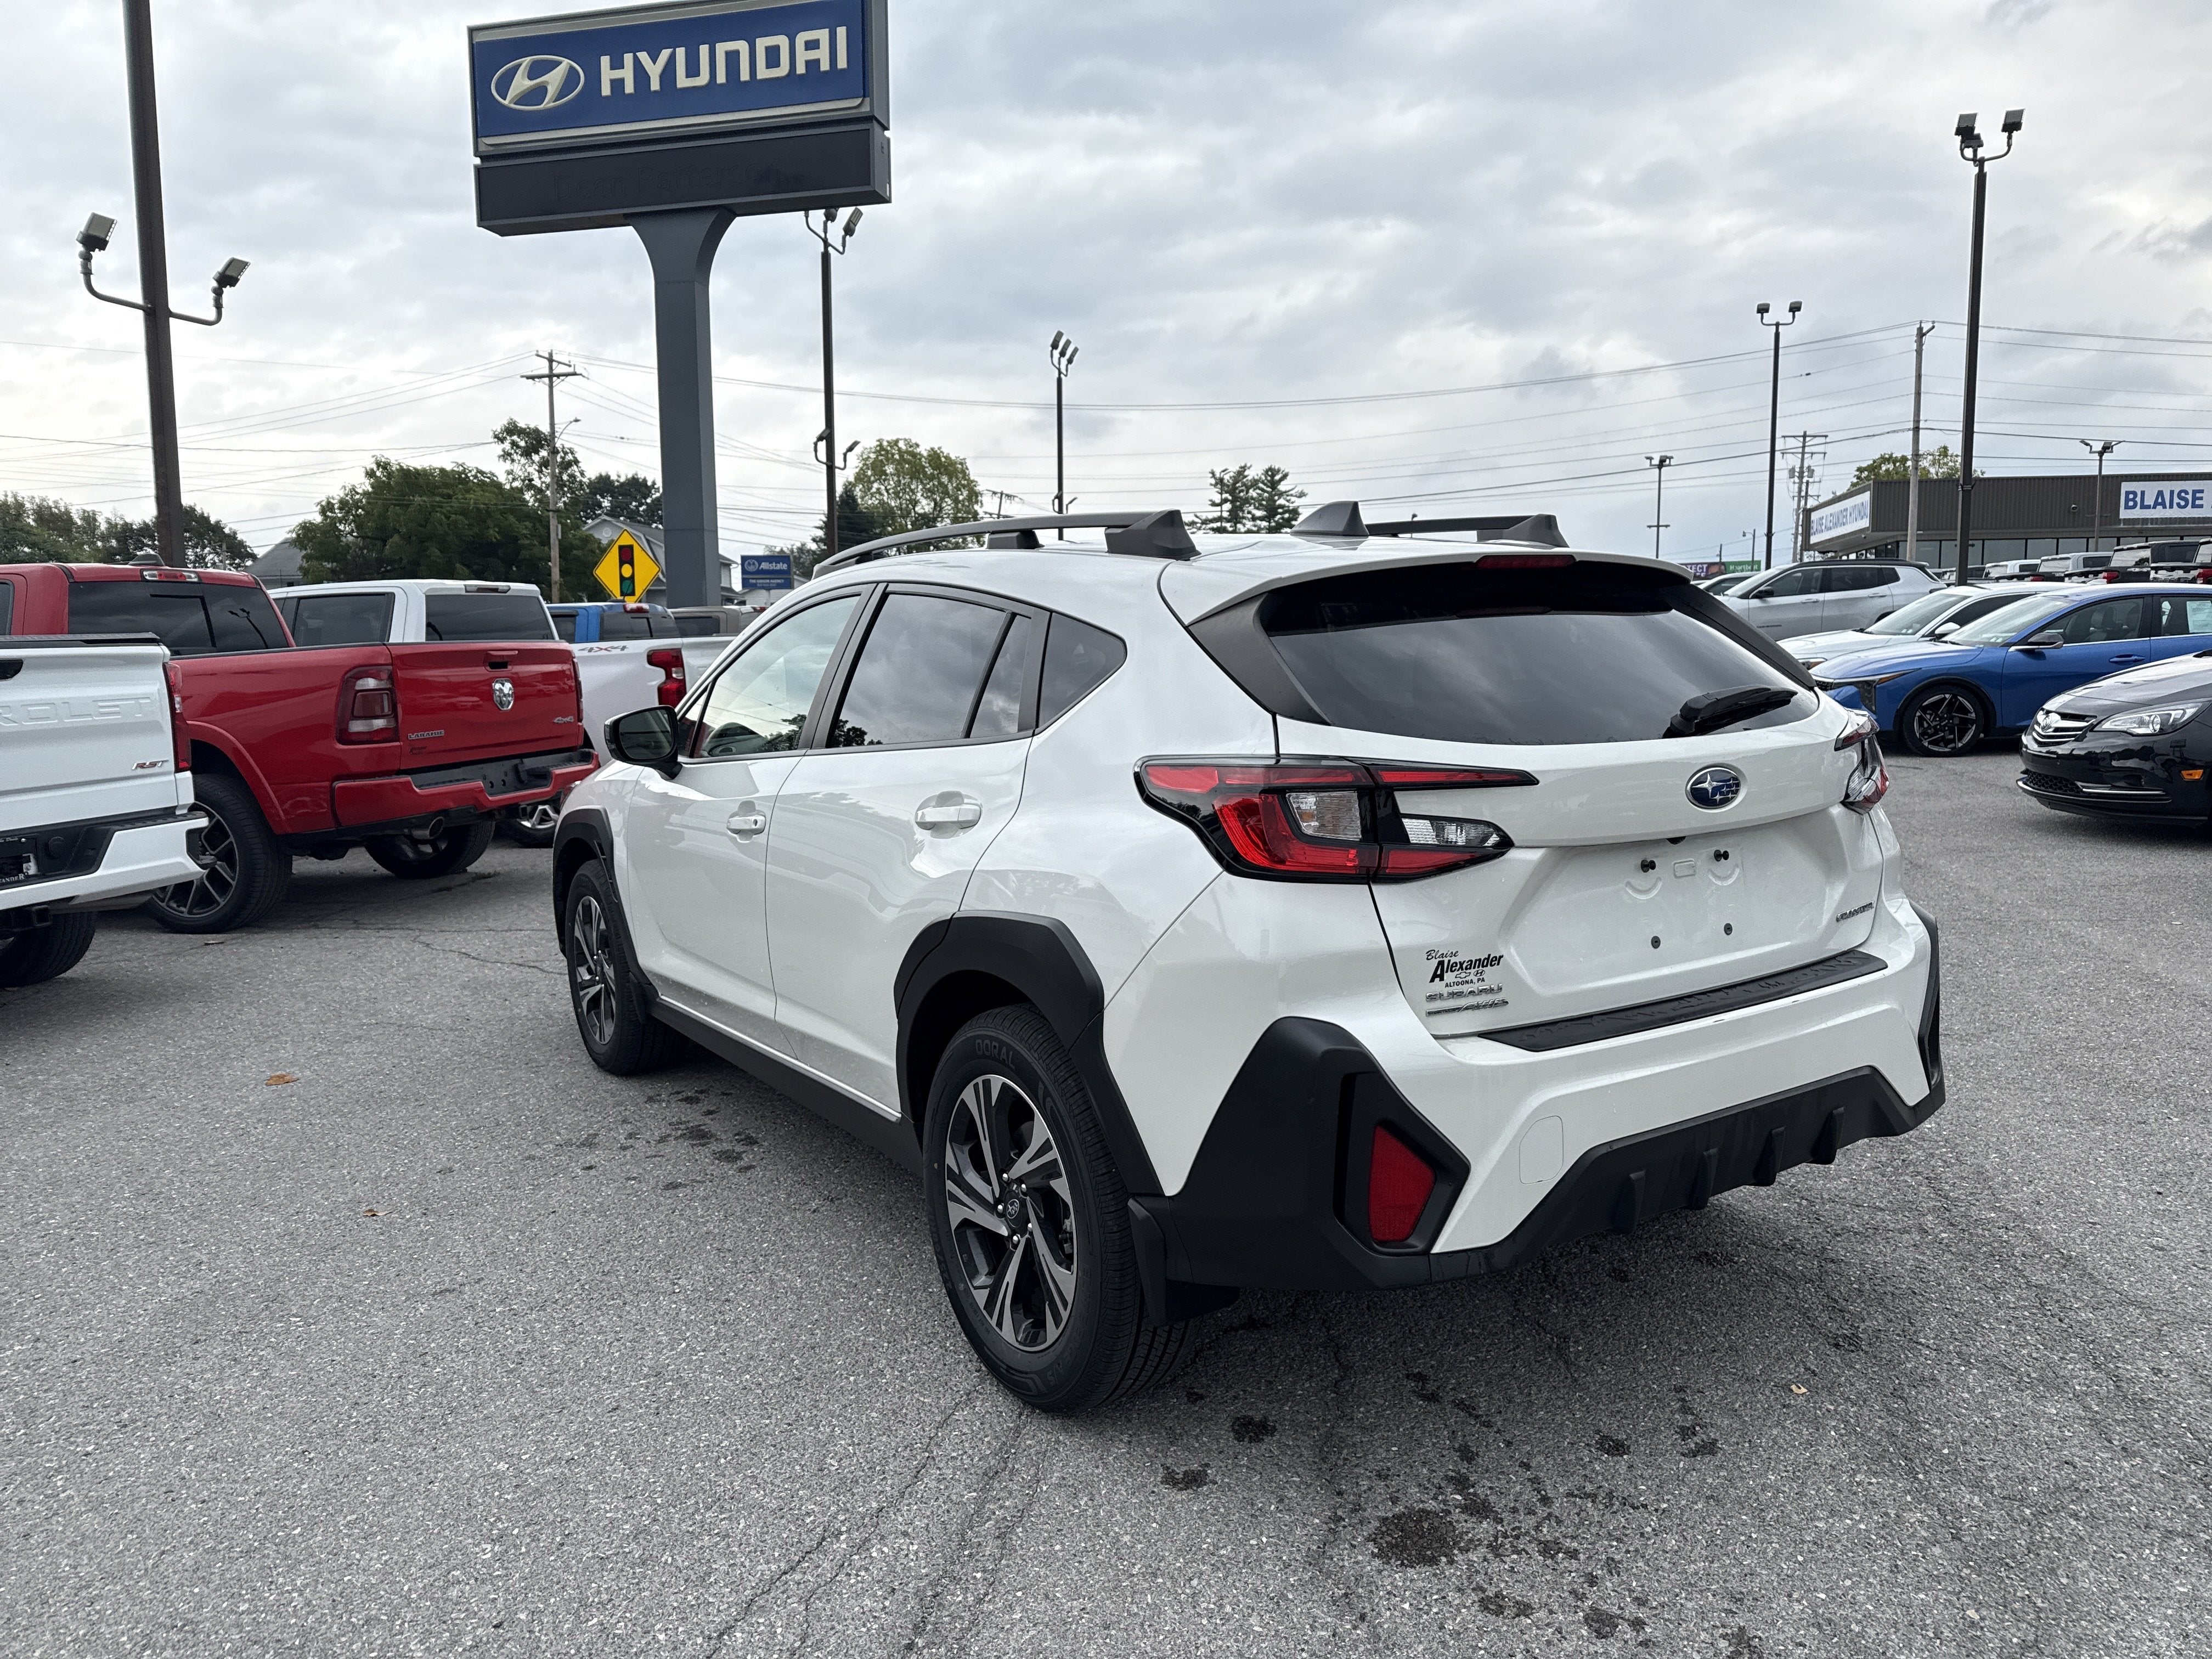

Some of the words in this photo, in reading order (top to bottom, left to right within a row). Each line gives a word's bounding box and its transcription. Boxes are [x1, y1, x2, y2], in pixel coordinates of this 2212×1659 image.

[600, 26, 848, 97] HYUNDAI
[2124, 489, 2204, 510] BLAISE
[1811, 516, 1824, 536] BLAISE
[1824, 506, 1848, 532] ALEXANDER
[1848, 499, 1869, 524] HYUNDAI
[759, 562, 788, 570] Allstate
[408, 730, 445, 740] LARAMIE
[132, 759, 169, 770] RST
[1426, 949, 1459, 961] Blaise
[1429, 953, 1504, 983] Alexander
[1444, 979, 1476, 988] ALTOONA,
[1426, 984, 1503, 1002] SUBARU
